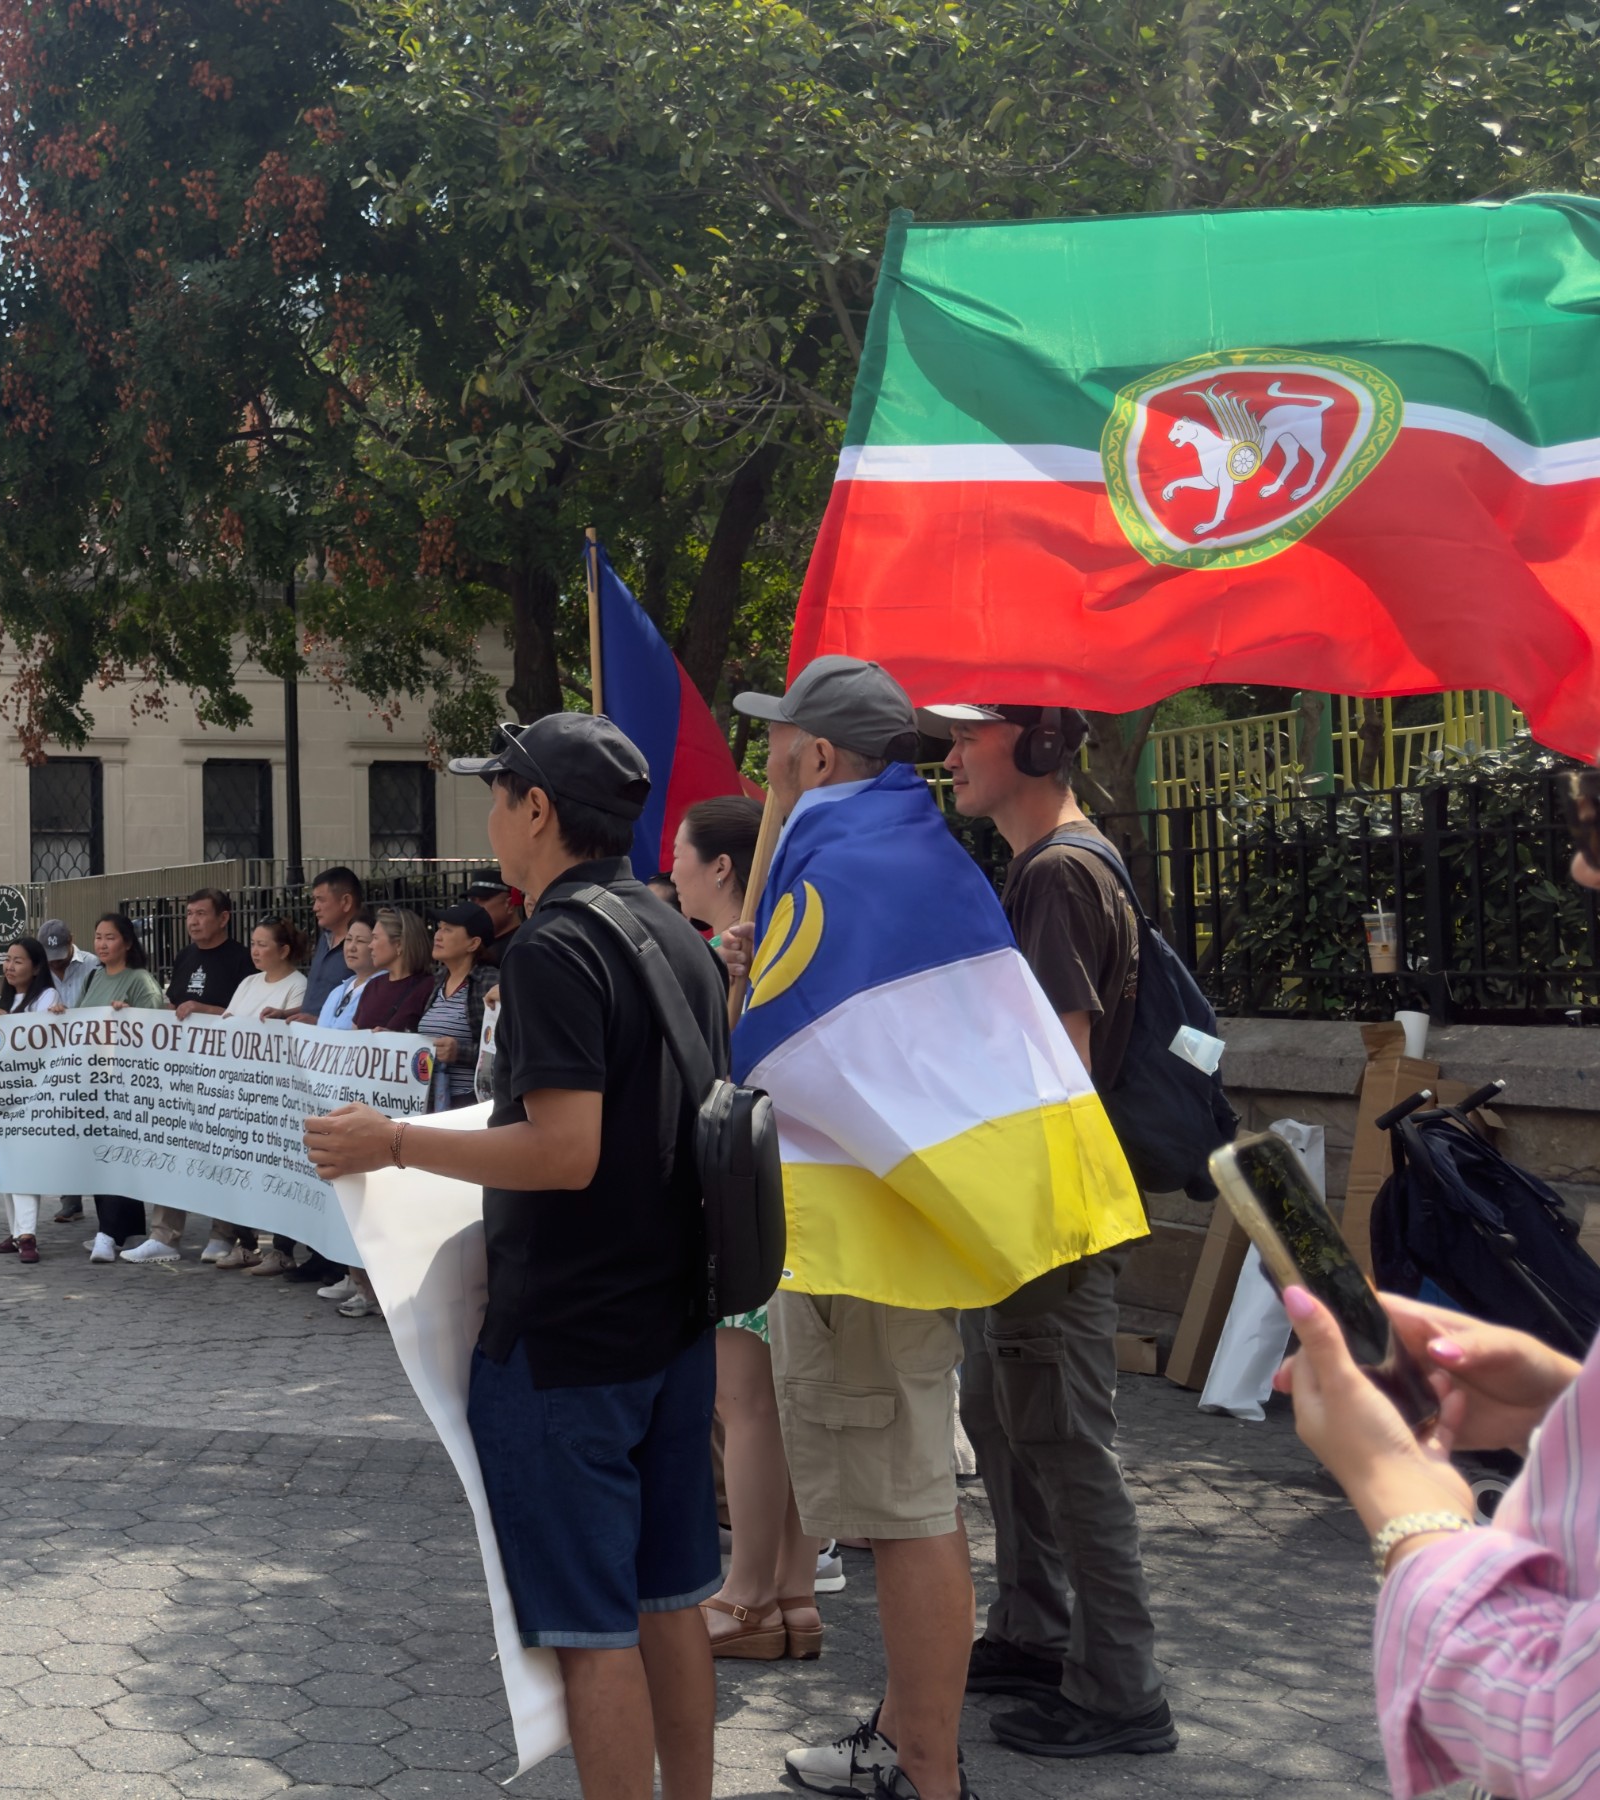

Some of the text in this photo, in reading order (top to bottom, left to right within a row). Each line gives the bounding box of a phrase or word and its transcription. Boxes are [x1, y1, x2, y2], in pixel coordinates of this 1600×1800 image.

[11, 1020, 144, 1052] CONGRESS
[151, 1023, 183, 1051] OF
[187, 1026, 227, 1057] THE
[340, 1045, 408, 1084] PEOPLE
[88, 1054, 159, 1072] democratic
[163, 1062, 216, 1078] opposition
[219, 1068, 274, 1086] organization
[275, 1076, 290, 1088] was
[313, 1082, 332, 1099] 2015
[130, 1074, 162, 1092] 2023,
[170, 1080, 194, 1094] when
[237, 1088, 279, 1107] Supreme
[31, 1107, 109, 1122] prohibited,
[113, 1109, 132, 1121] and
[135, 1111, 149, 1124] all
[152, 1114, 186, 1131] people
[189, 1119, 204, 1134] who
[206, 1122, 249, 1145] belonging
[252, 1130, 264, 1144] to
[267, 1132, 282, 1147] this
[283, 1137, 302, 1156] group
[60, 1089, 98, 1102] ruled
[104, 1089, 129, 1104] that
[133, 1094, 155, 1110] any
[158, 1094, 195, 1116] activity
[197, 1103, 216, 1116] and
[219, 1107, 278, 1127] participation
[280, 1114, 289, 1127] of
[290, 1116, 300, 1131] the
[5, 1124, 80, 1139] persecuted,
[83, 1124, 141, 1140] detained,
[143, 1132, 164, 1144] and
[212, 1142, 222, 1156] to
[222, 1145, 254, 1162] prison
[255, 1151, 282, 1168] under
